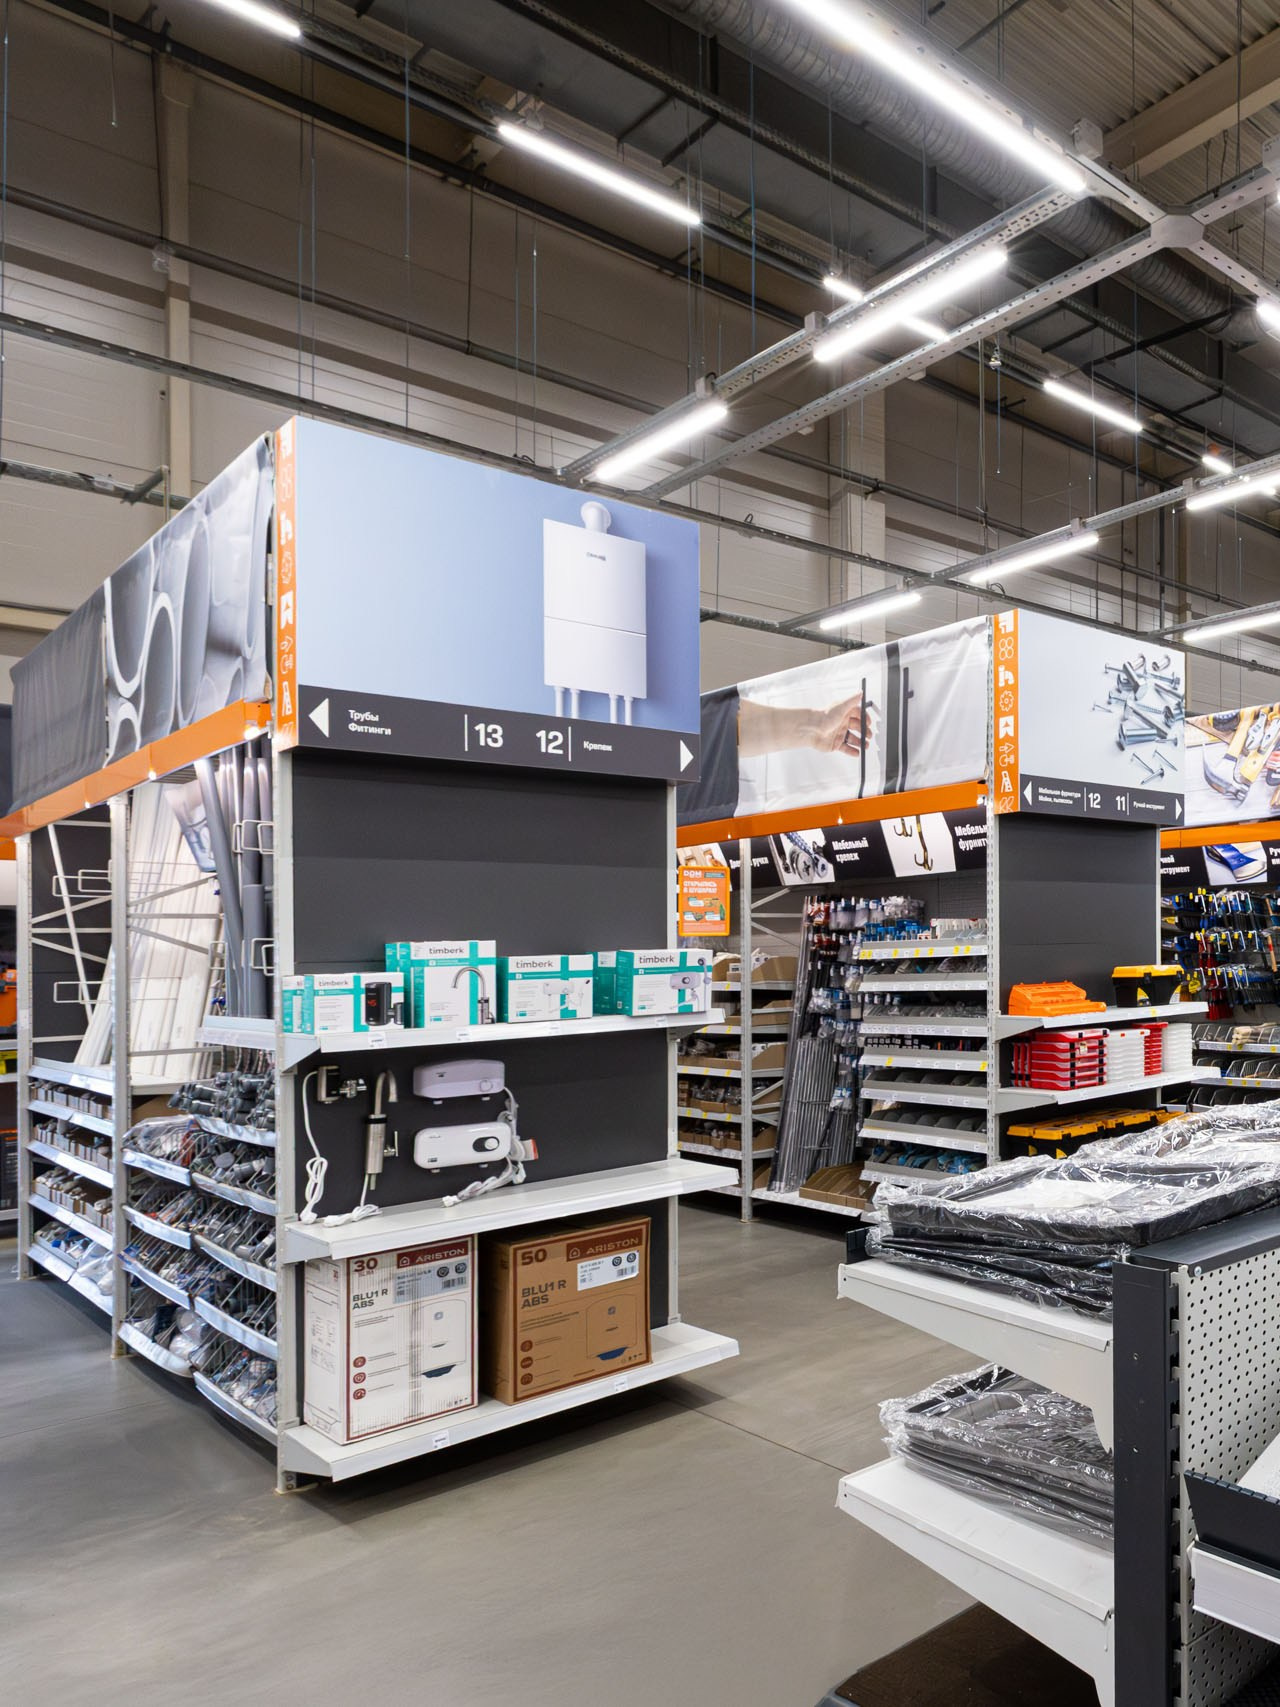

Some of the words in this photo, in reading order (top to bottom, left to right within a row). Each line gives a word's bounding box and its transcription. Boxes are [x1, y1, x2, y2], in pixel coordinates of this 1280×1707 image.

[348, 709, 379, 723] Трубы
[348, 722, 392, 736] Фитинги
[474, 723, 503, 748] 13
[535, 730, 564, 754] 12
[583, 741, 613, 752] Крепеж
[1088, 793, 1101, 809] 12
[1115, 795, 1126, 811] 11
[832, 837, 869, 851] Мебельный
[835, 852, 860, 864] крепеж
[429, 946, 465, 955] timberk
[516, 960, 554, 969] timberk
[639, 954, 675, 965] timberk
[586, 1237, 639, 1255] ARISTON
[416, 1248, 465, 1263] ARISTON
[521, 1248, 547, 1266] 50
[353, 1257, 379, 1273] 30
[352, 1290, 379, 1302] BLU1
[381, 1288, 389, 1296] R
[521, 1281, 555, 1298] BLU1
[558, 1279, 567, 1289] R
[352, 1299, 375, 1310] ABS
[521, 1294, 549, 1309] ABS
